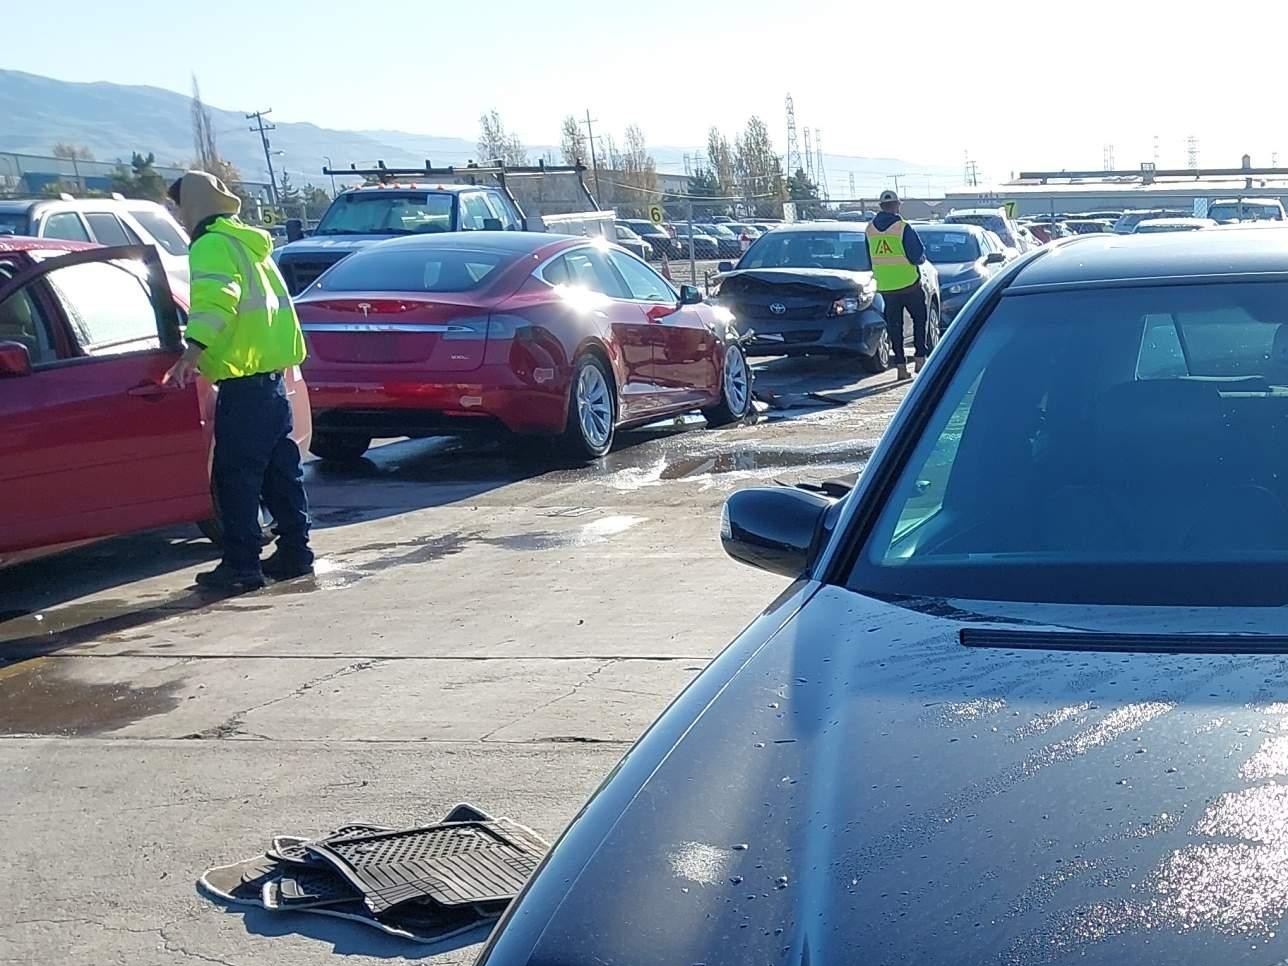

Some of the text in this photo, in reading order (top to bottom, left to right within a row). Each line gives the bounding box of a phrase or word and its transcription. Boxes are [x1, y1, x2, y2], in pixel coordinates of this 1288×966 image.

[263, 209, 272, 223] 5
[651, 207, 661, 222] 6
[1006, 202, 1015, 217] 7
